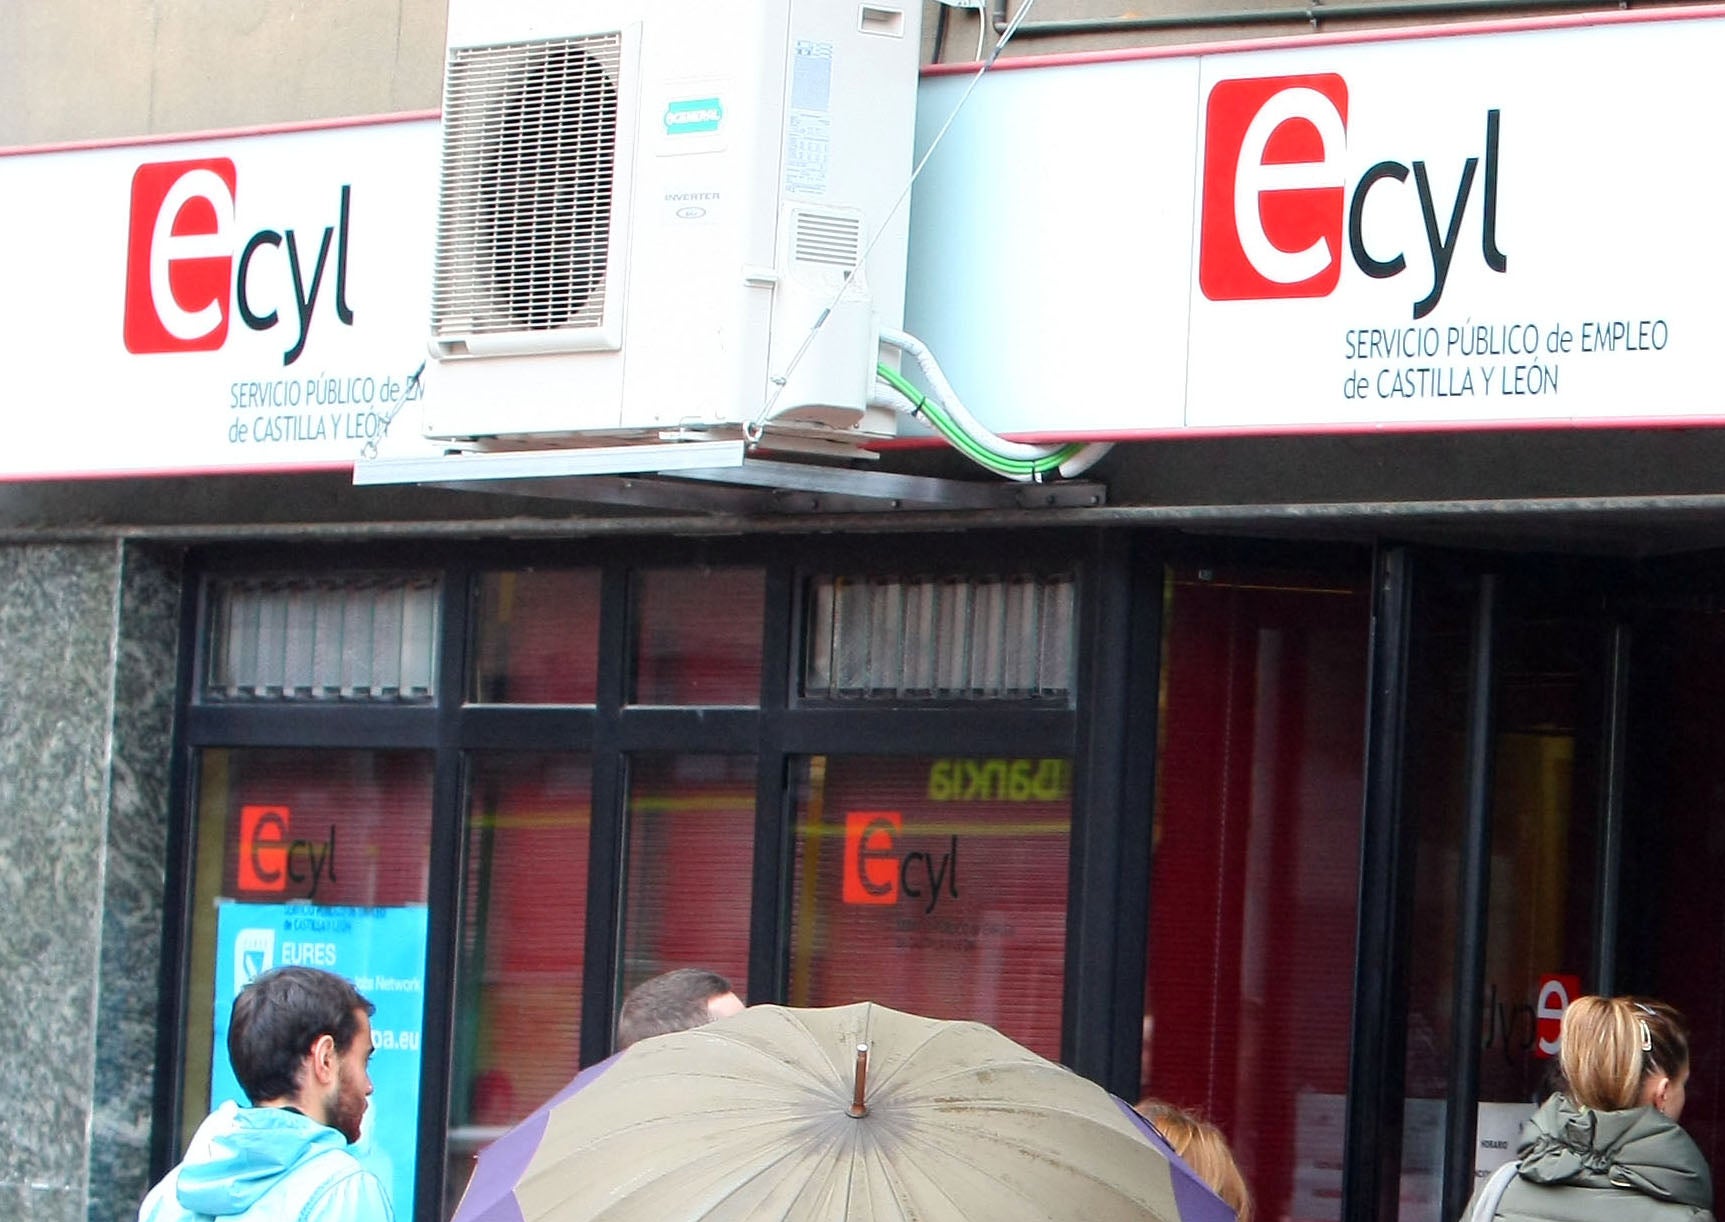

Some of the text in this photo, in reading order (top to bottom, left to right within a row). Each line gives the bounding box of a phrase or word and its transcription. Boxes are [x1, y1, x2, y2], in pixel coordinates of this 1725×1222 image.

[1234, 87, 1506, 319] ecyl
[151, 169, 353, 366] ecyl
[1345, 317, 1668, 359] SERVICIO PÚBLICO de EMPLEO
[231, 381, 300, 408] SERVICIO
[306, 372, 375, 405] PÚBLICO
[380, 376, 400, 402] de
[1344, 356, 1558, 399] de CASTILLA Y LEÓN
[229, 417, 248, 443] de
[253, 415, 326, 442] CASTILLA
[330, 414, 341, 440] Y
[251, 812, 336, 899] ecyl
[858, 817, 959, 914] ecyl
[282, 942, 336, 965] EURES
